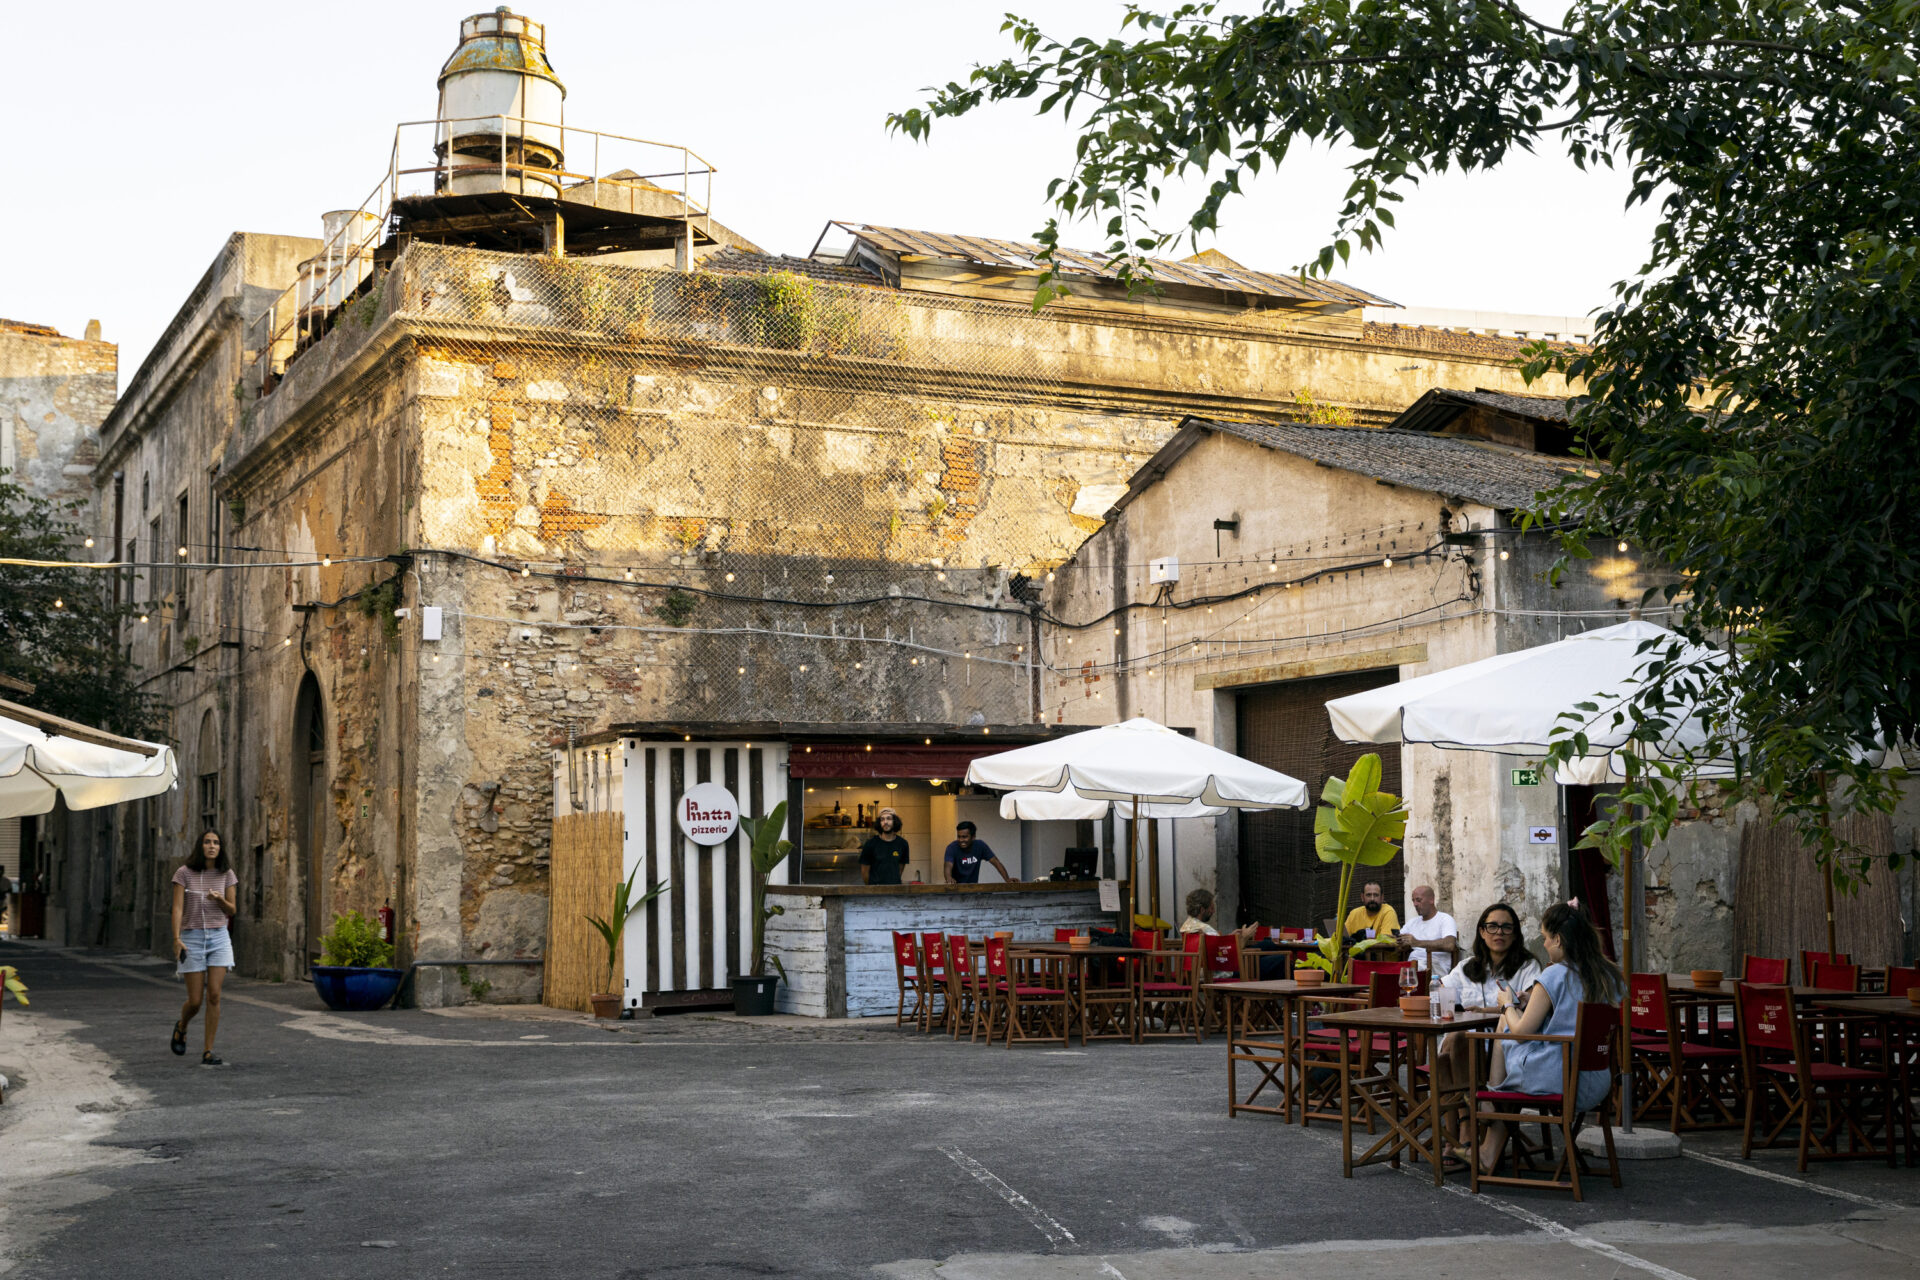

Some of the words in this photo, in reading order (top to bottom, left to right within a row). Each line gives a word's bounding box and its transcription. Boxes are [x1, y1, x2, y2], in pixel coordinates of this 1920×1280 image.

[686, 798, 698, 821] la
[690, 809, 732, 821] matta
[691, 825, 728, 836] pizzeria
[962, 856, 978, 865] FILA
